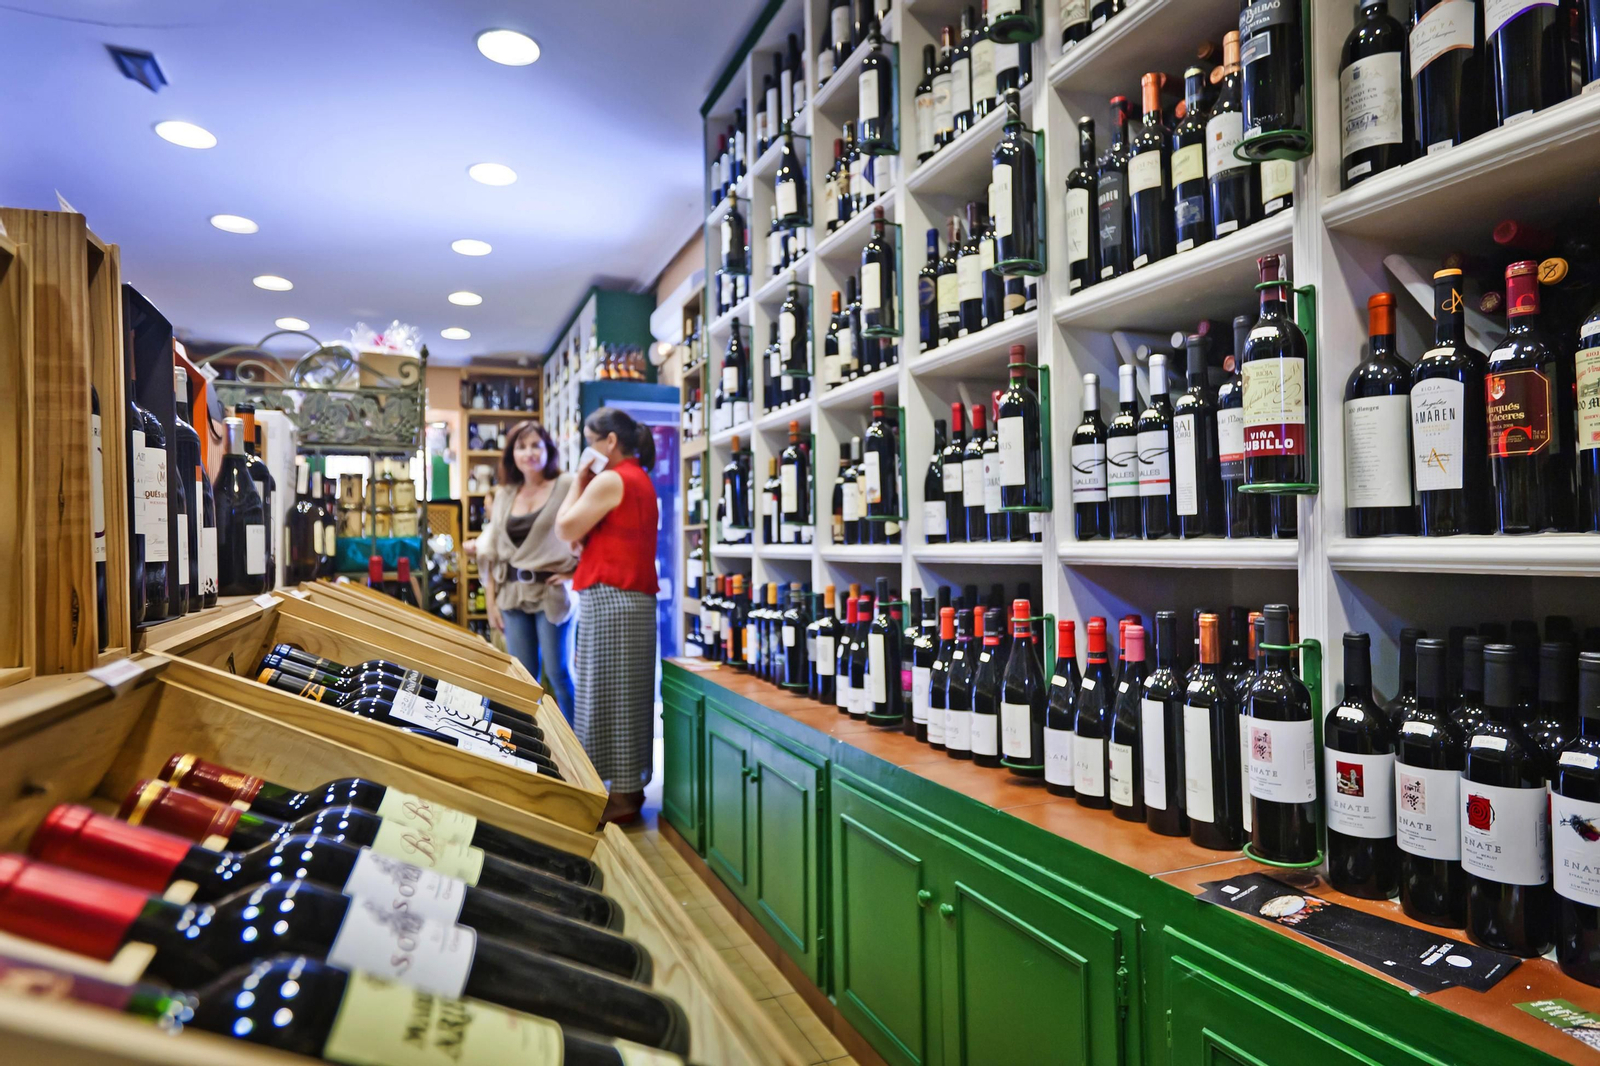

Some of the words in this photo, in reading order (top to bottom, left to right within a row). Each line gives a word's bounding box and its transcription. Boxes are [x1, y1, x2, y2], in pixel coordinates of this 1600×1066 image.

[1415, 407, 1456, 425] AMAREN
[1489, 411, 1525, 423] Cáceres
[1250, 430, 1275, 440] VIÑA
[1334, 800, 1370, 813] ENATE
[1398, 815, 1432, 831] ENATE
[1464, 836, 1502, 853] ENATE
